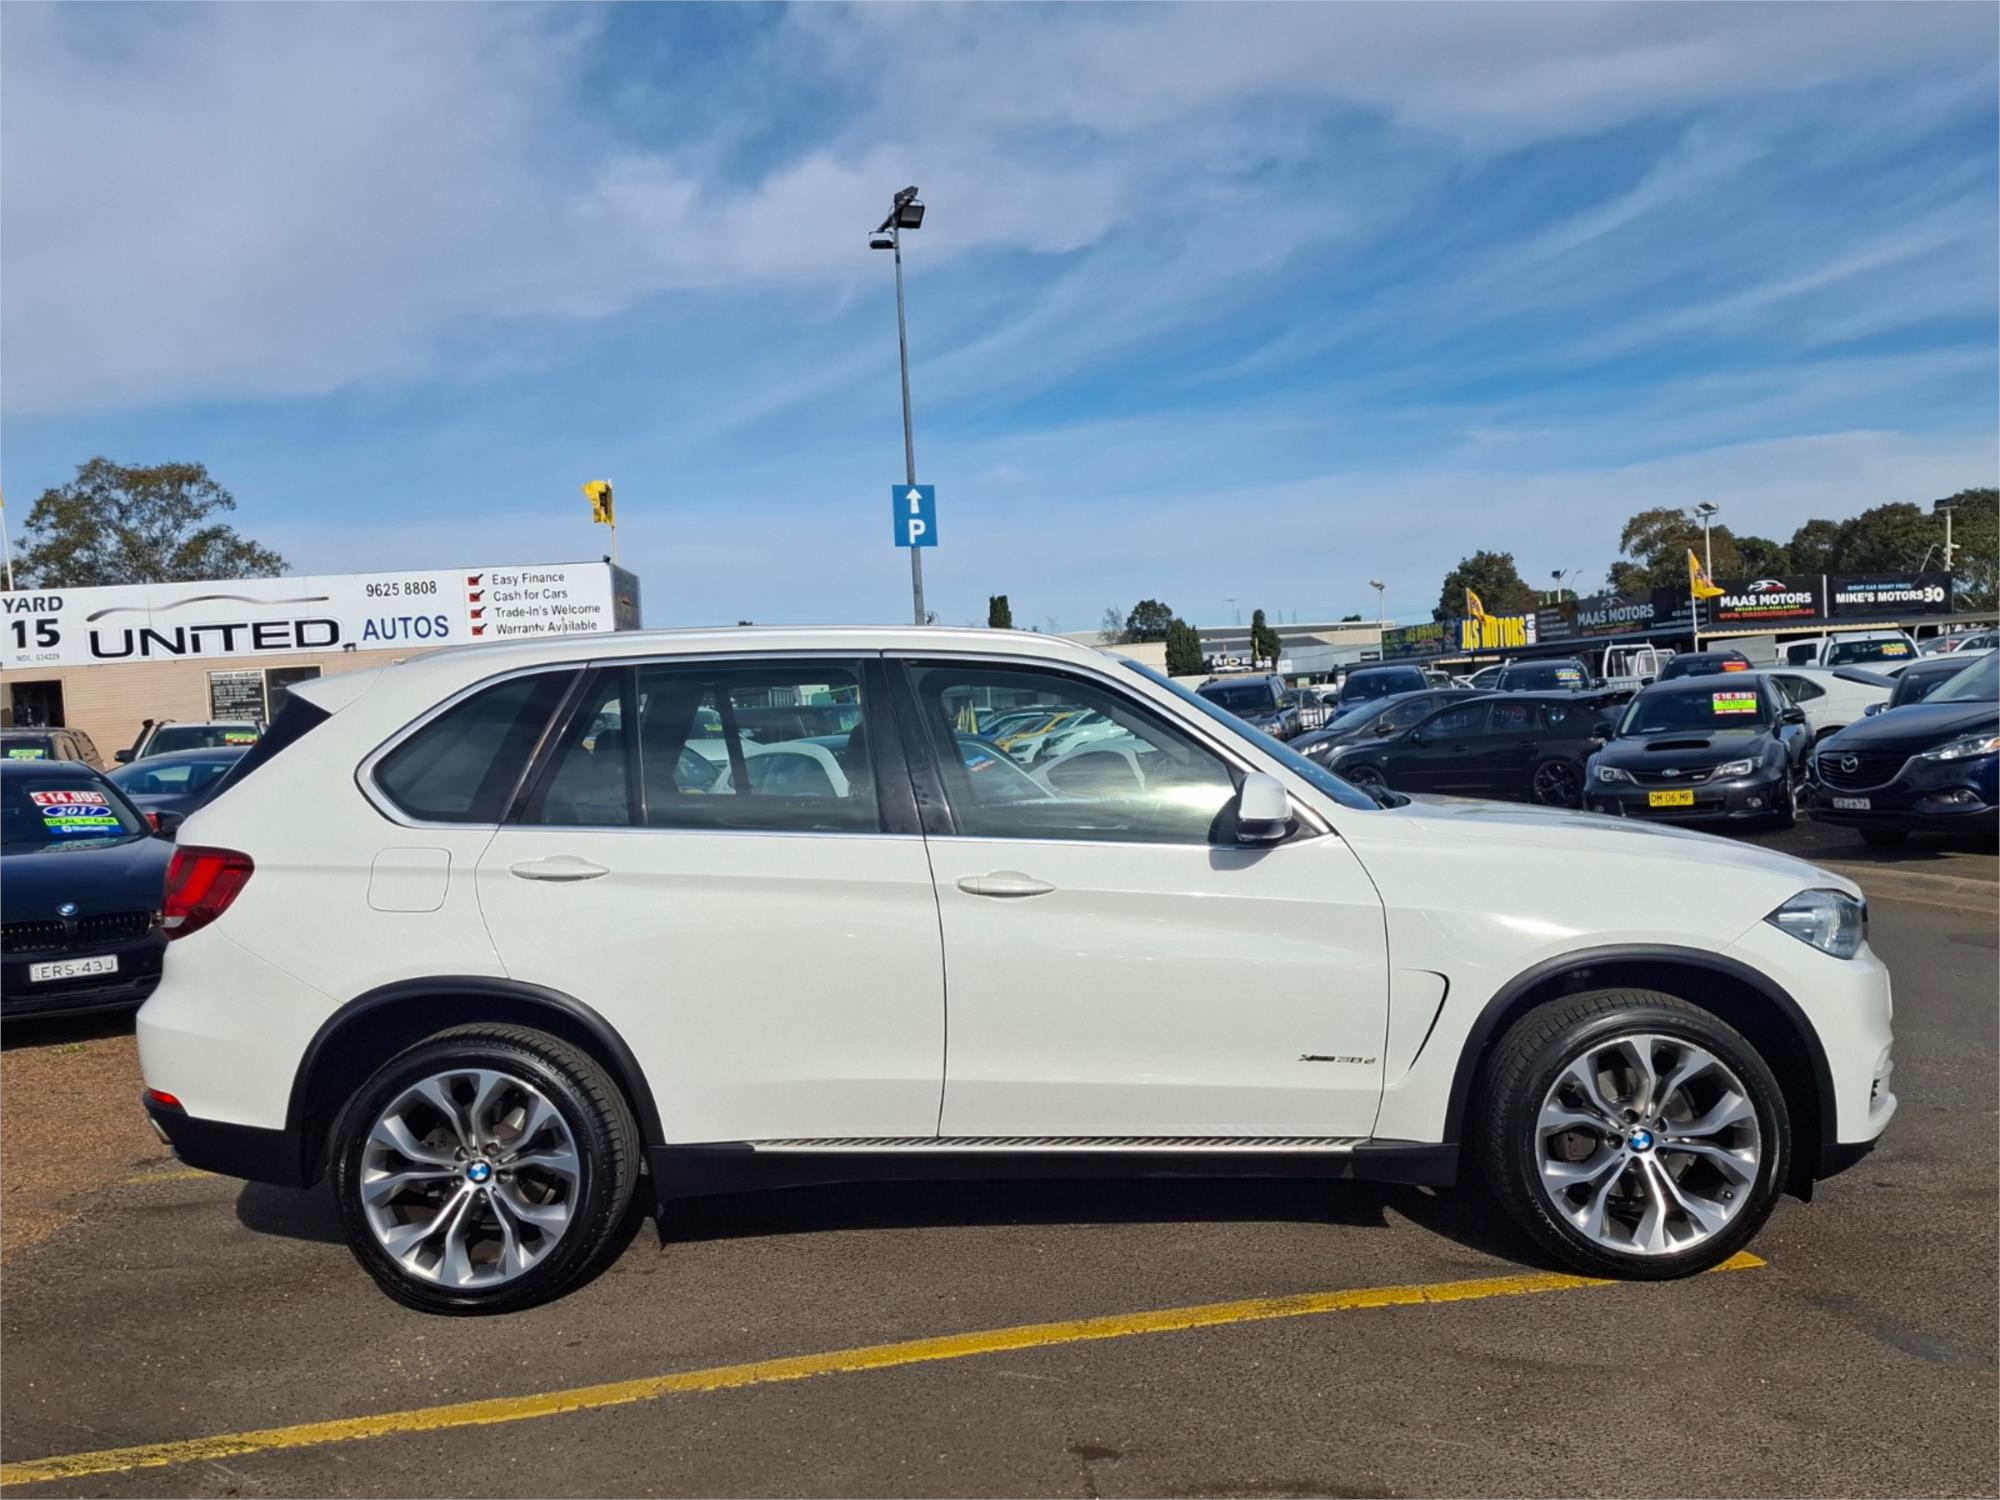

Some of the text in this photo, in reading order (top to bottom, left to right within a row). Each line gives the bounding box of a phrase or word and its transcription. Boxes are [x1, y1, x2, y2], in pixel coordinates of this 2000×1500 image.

[908, 518, 926, 545] P
[366, 580, 437, 597] 9625 8808
[492, 573, 565, 587] Easy Finance
[493, 588, 568, 602] Cash for Cars
[1720, 592, 1812, 608] MAAS MOTORS
[1835, 586, 1945, 604] MIKE'S MOTORS 30
[3, 596, 64, 613] YARD
[495, 604, 600, 618] Trade-In's Welcome
[1577, 609, 1607, 626] MAAS
[1609, 603, 1655, 622] MOTORS
[11, 618, 61, 649] 15
[496, 619, 597, 635] Warranty Available
[1482, 615, 1526, 648] MOTORS
[89, 615, 449, 659] UNITED AUTOS
[56, 806, 97, 816] 2017
[47, 817, 77, 825] IDEAL
[94, 817, 115, 825] CAR
